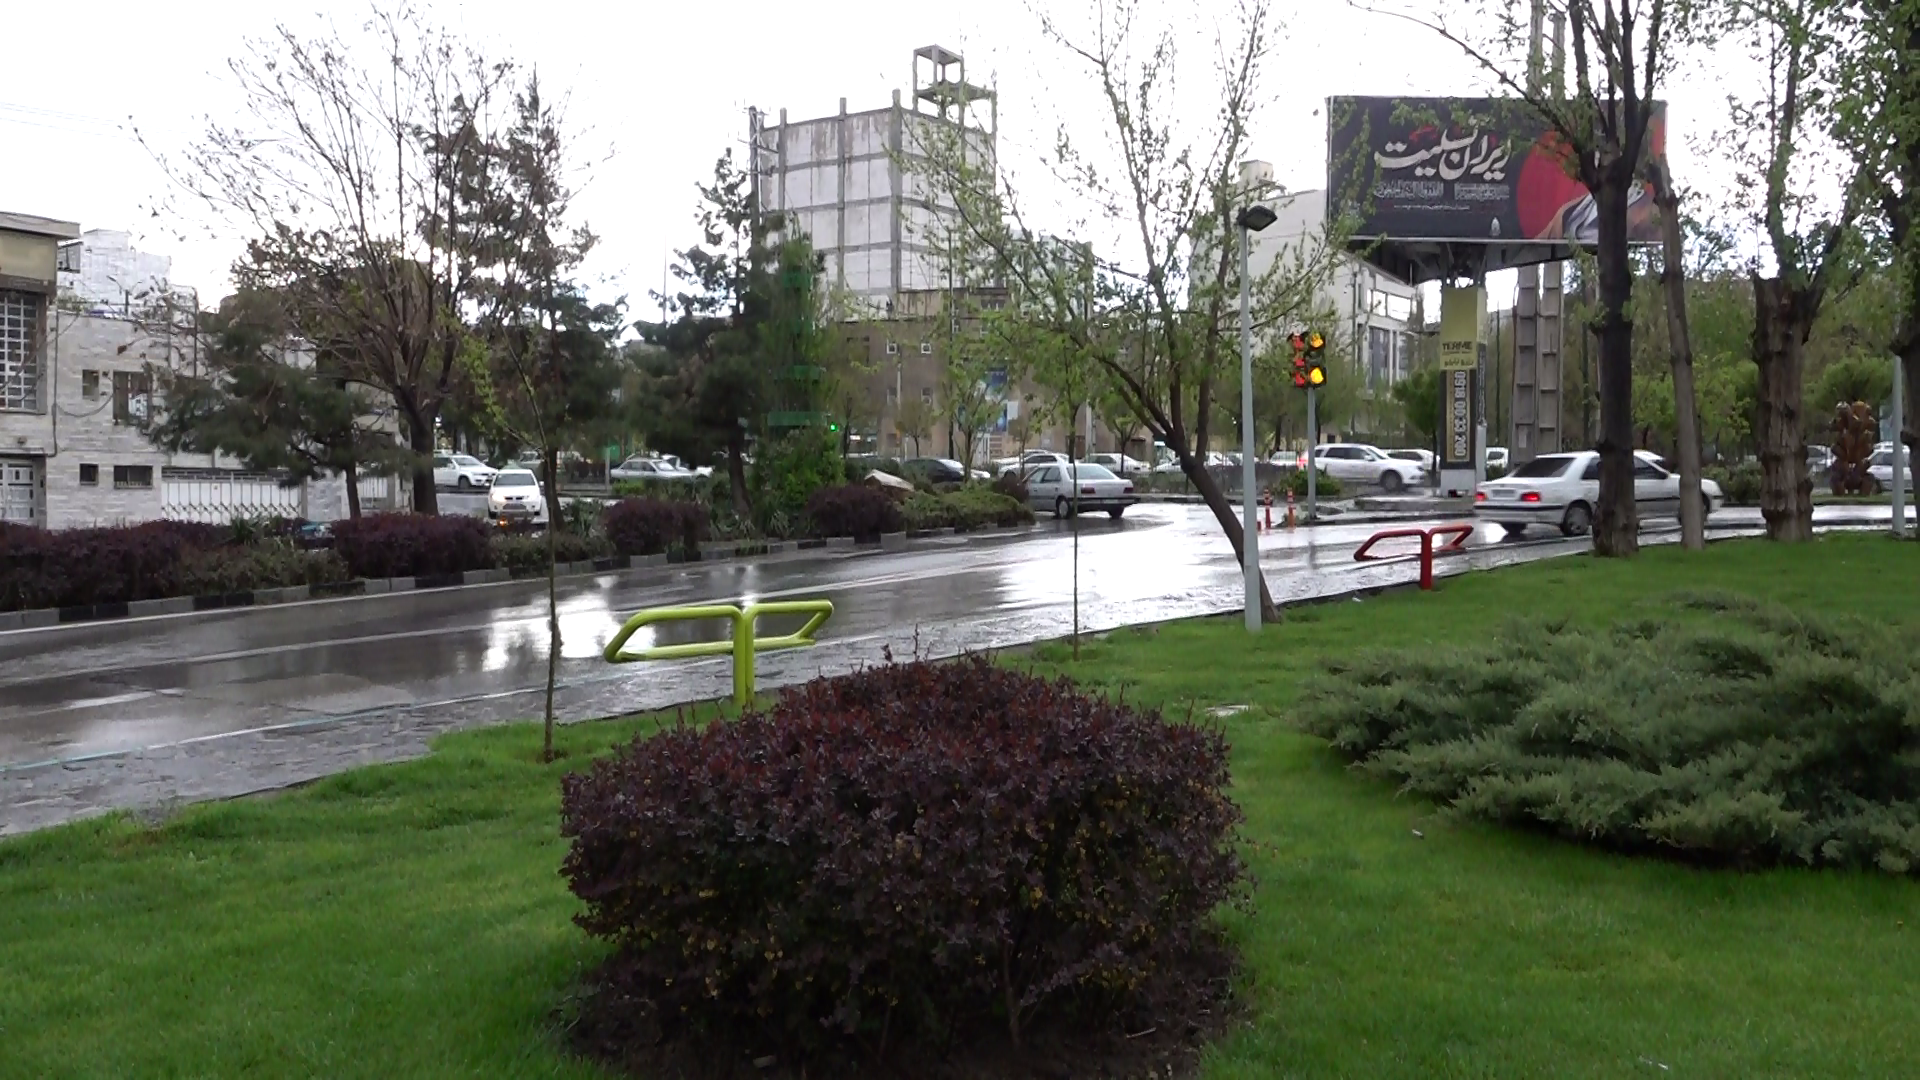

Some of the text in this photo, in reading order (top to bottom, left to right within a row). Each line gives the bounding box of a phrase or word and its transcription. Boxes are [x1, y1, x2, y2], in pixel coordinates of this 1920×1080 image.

[1374, 115, 1512, 180] ایران تسلیت
[1442, 341, 1473, 350] TERME
